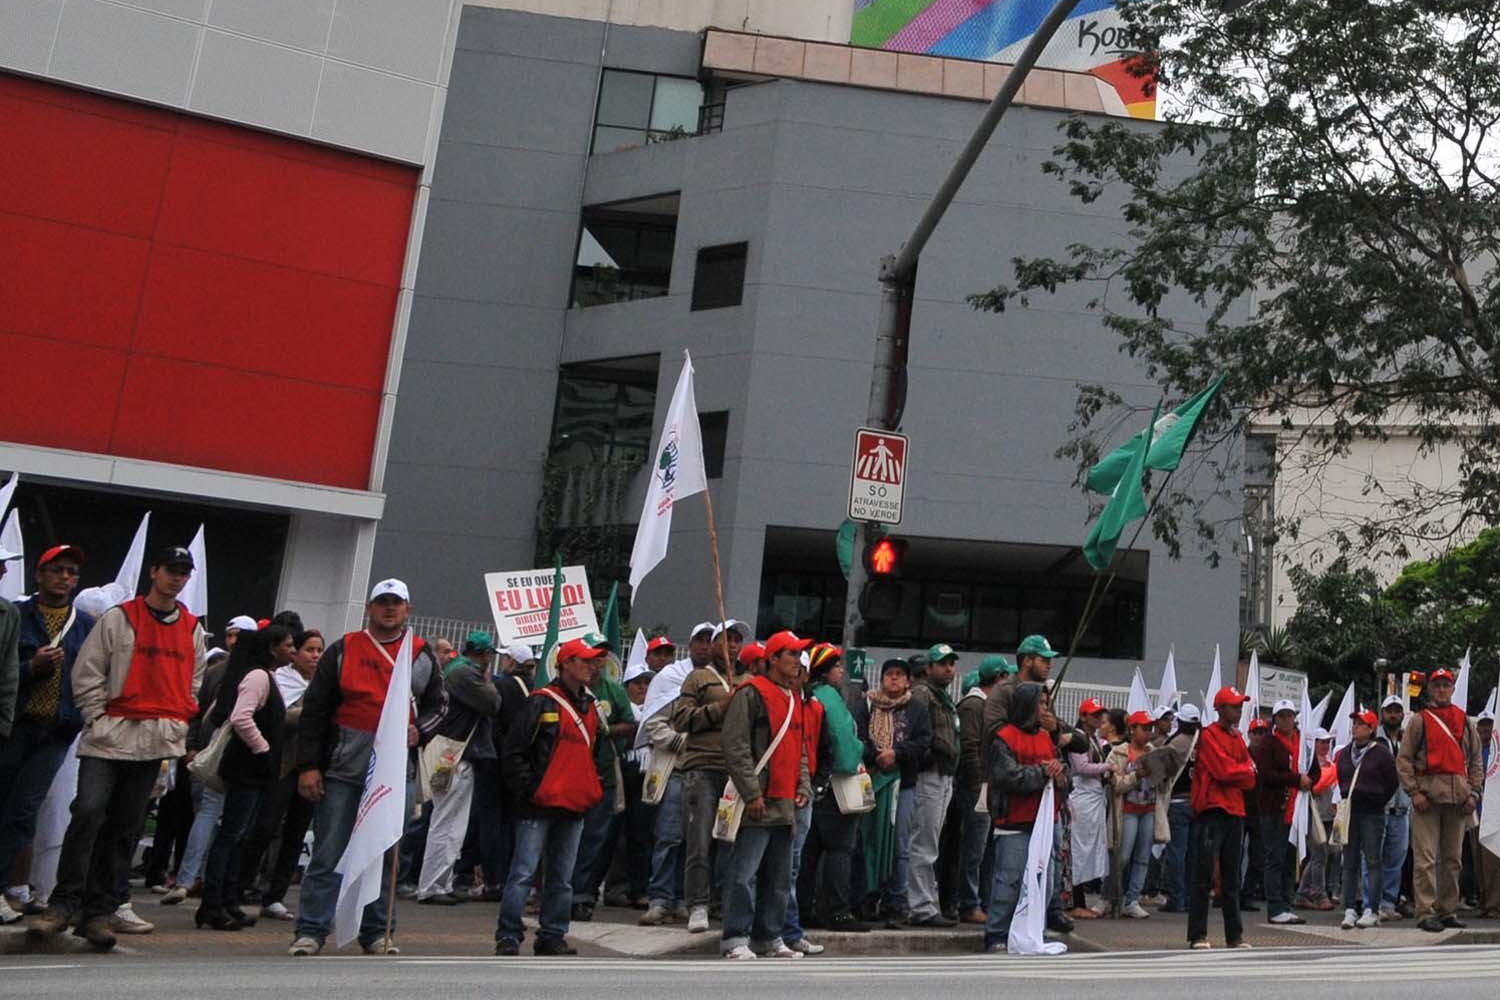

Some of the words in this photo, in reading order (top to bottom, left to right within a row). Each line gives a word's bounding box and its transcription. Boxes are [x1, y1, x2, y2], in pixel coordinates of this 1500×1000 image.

[854, 496, 899, 510] ATRAVESSE
[853, 507, 866, 516] NO
[870, 508, 897, 520] VERDE
[506, 577, 518, 588] SE
[521, 576, 533, 587] EU
[495, 588, 522, 612] EU
